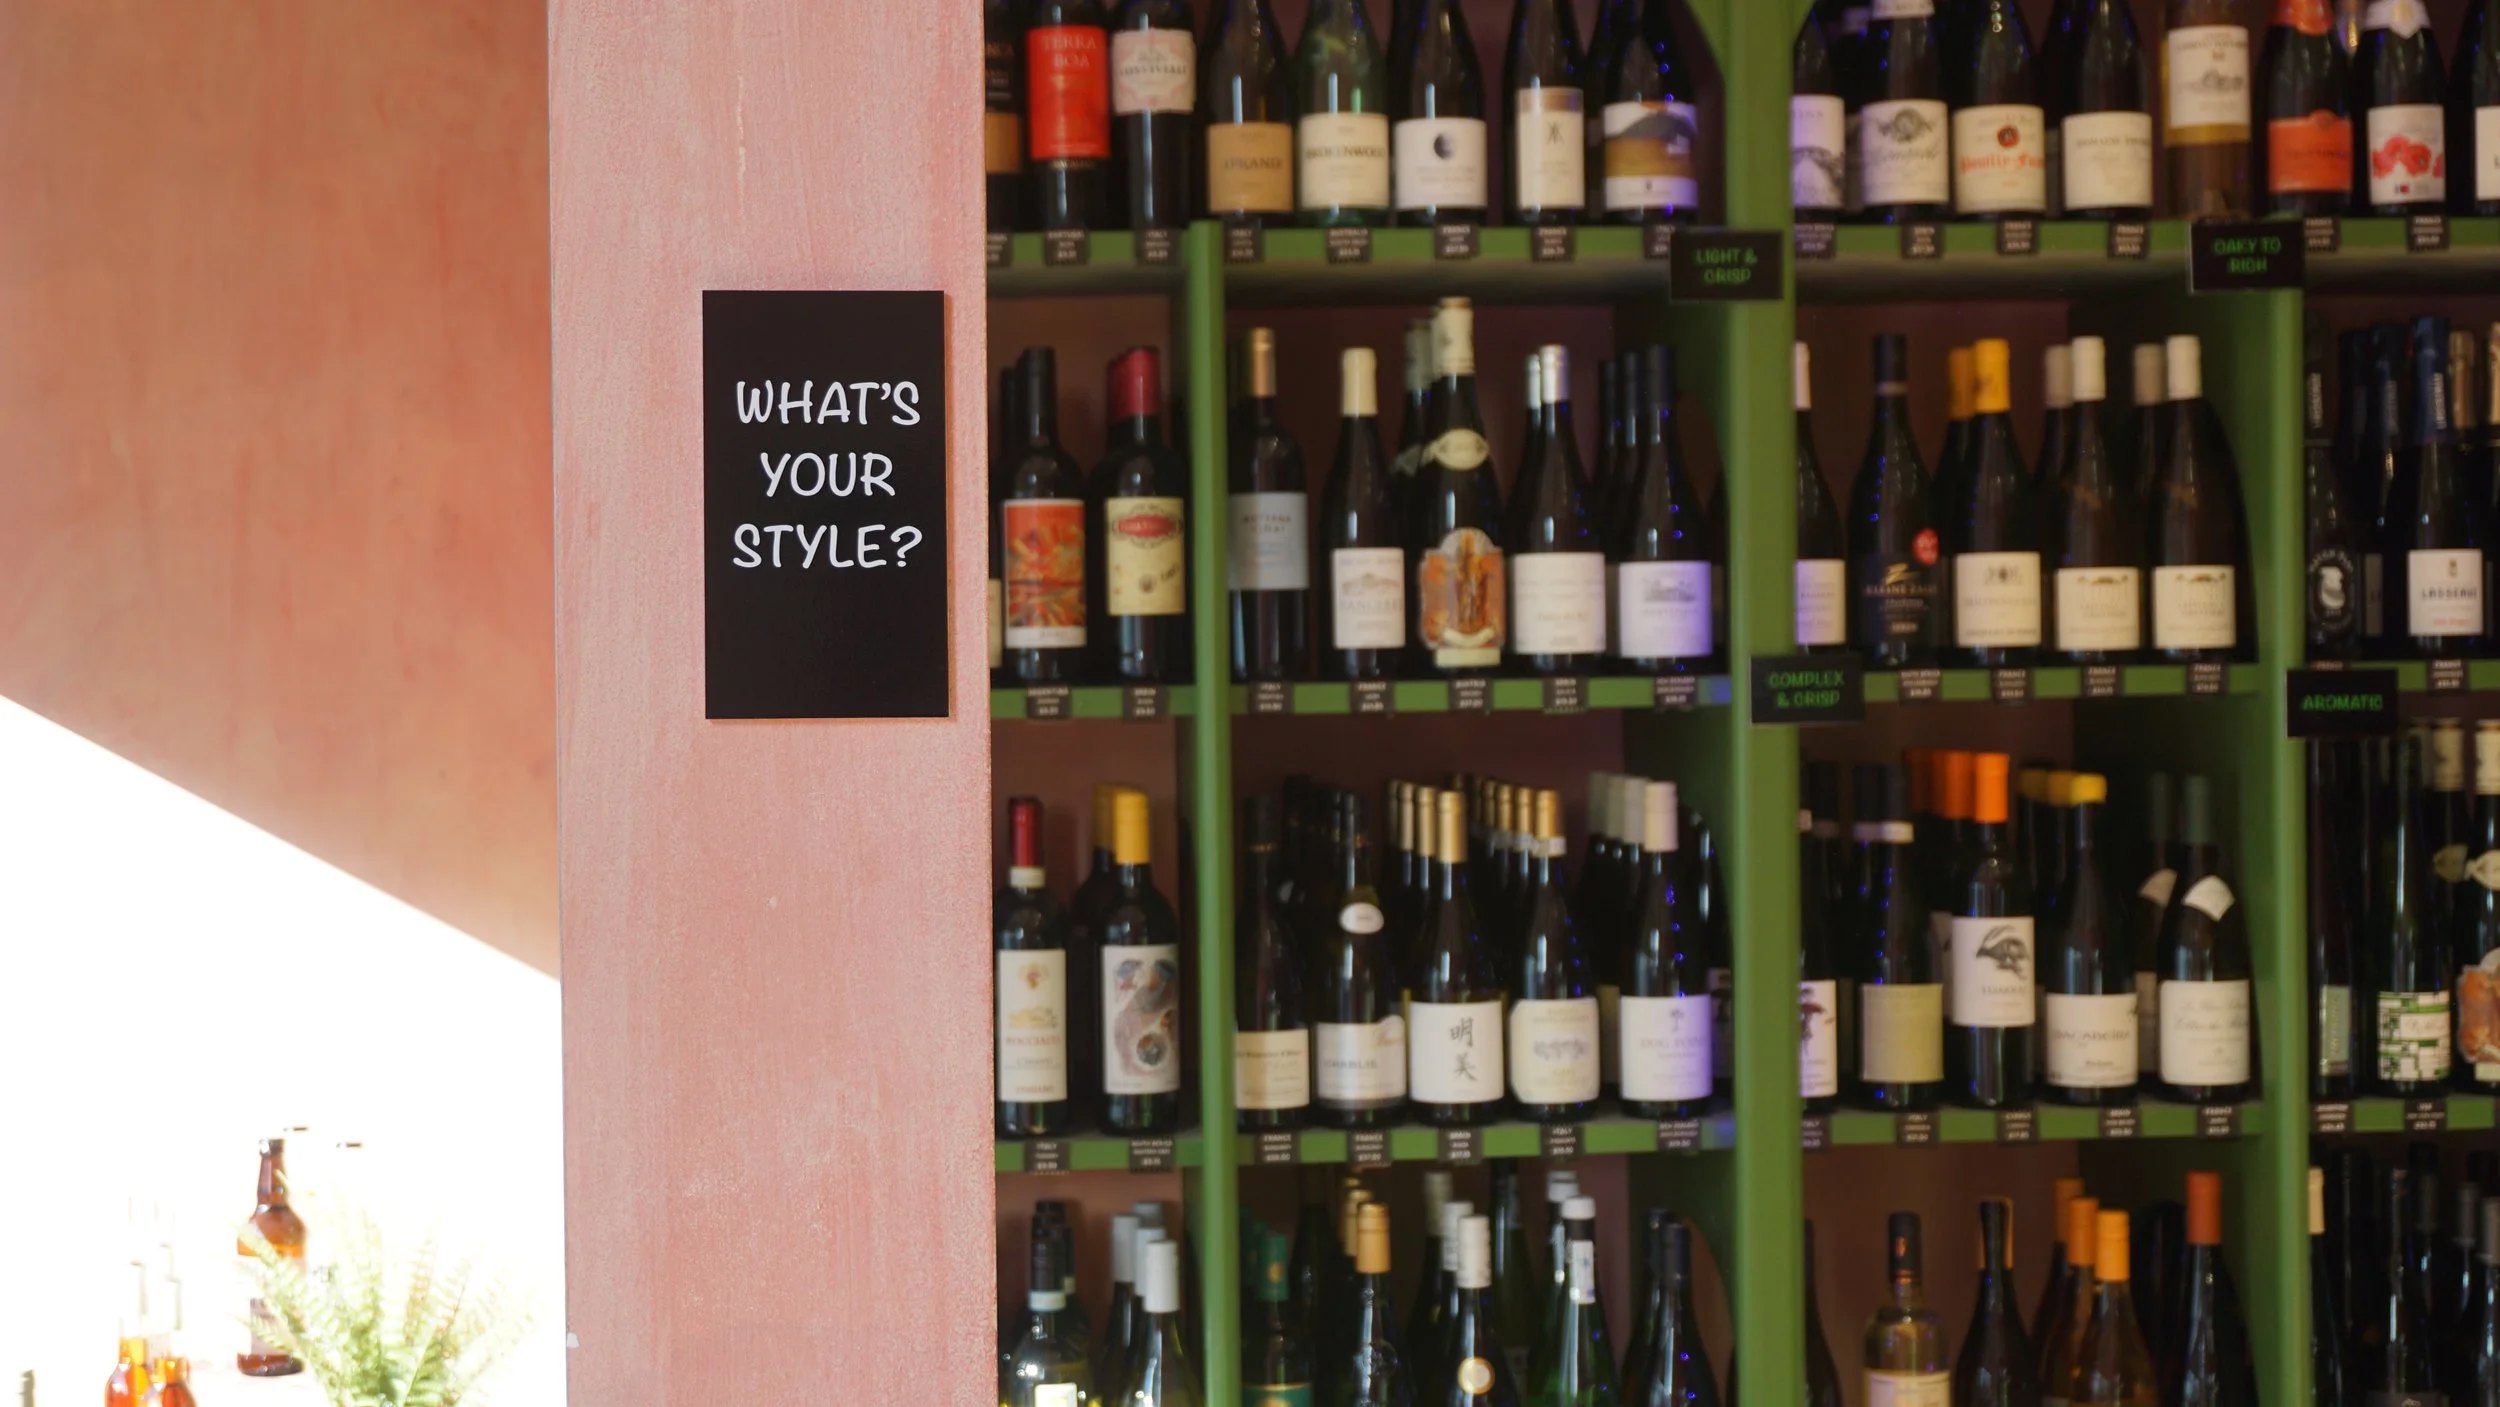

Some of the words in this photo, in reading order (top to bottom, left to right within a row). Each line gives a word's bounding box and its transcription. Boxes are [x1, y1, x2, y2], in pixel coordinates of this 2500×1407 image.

[1042, 35, 1097, 50] TERRA
[1053, 53, 1091, 68] BOA
[2213, 238, 2258, 257] OAKY
[2261, 236, 2282, 254] TO
[1695, 247, 1742, 266] LIGHT
[1744, 247, 1758, 265] &
[2228, 256, 2268, 274] RICH
[1704, 267, 1752, 285] CRISP
[736, 379, 921, 426] WHAT'S
[760, 452, 896, 498] YOUR
[733, 523, 923, 569] STYLE?
[1768, 669, 1845, 688] COMPLEX
[1777, 691, 1790, 708] &
[1794, 690, 1841, 707] CRISP
[2302, 694, 2384, 711] AROMATIC
